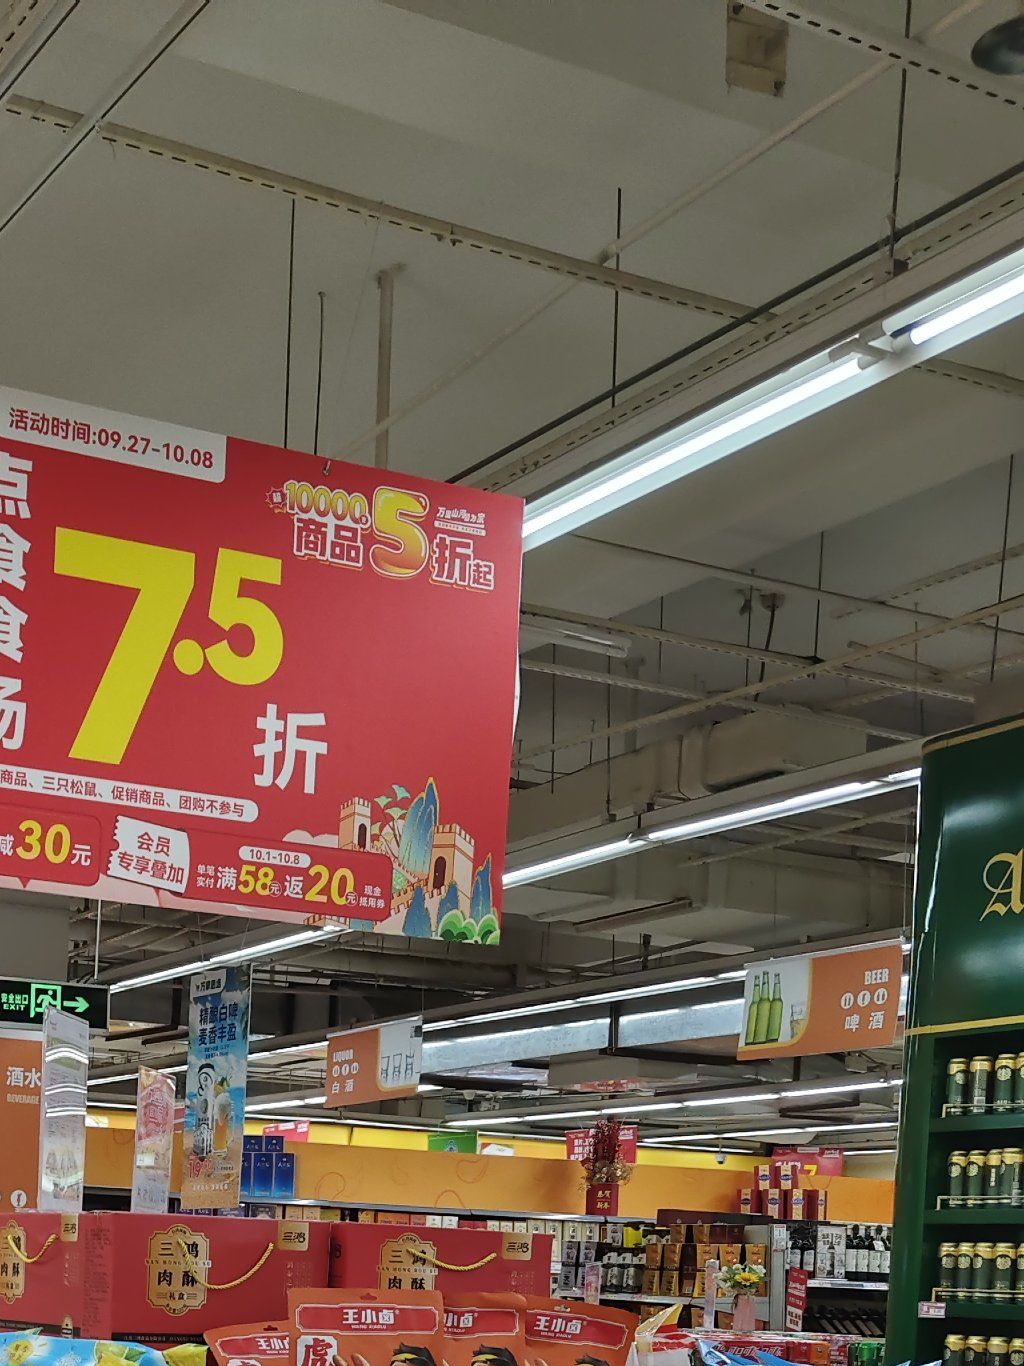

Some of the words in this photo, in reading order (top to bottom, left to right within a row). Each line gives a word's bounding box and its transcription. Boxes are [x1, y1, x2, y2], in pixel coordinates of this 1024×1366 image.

[9, 407, 214, 469] 活动时间:09.27-10.08
[137, 832, 171, 857] 会员
[249, 848, 300, 865] 10.1-10.8
[118, 851, 185, 885] 专享叠加
[864, 968, 889, 986] BEER
[3, 1003, 26, 1011] EXIT
[199, 1002, 239, 1026] 精酿白啤
[844, 1011, 885, 1032] 啤酒
[7, 1067, 42, 1087] 酒水
[331, 1079, 354, 1094] 白酒
[342, 1308, 396, 1325] 王小卤
[444, 1313, 473, 1328] 小卤
[534, 1315, 582, 1335] 王小卤
